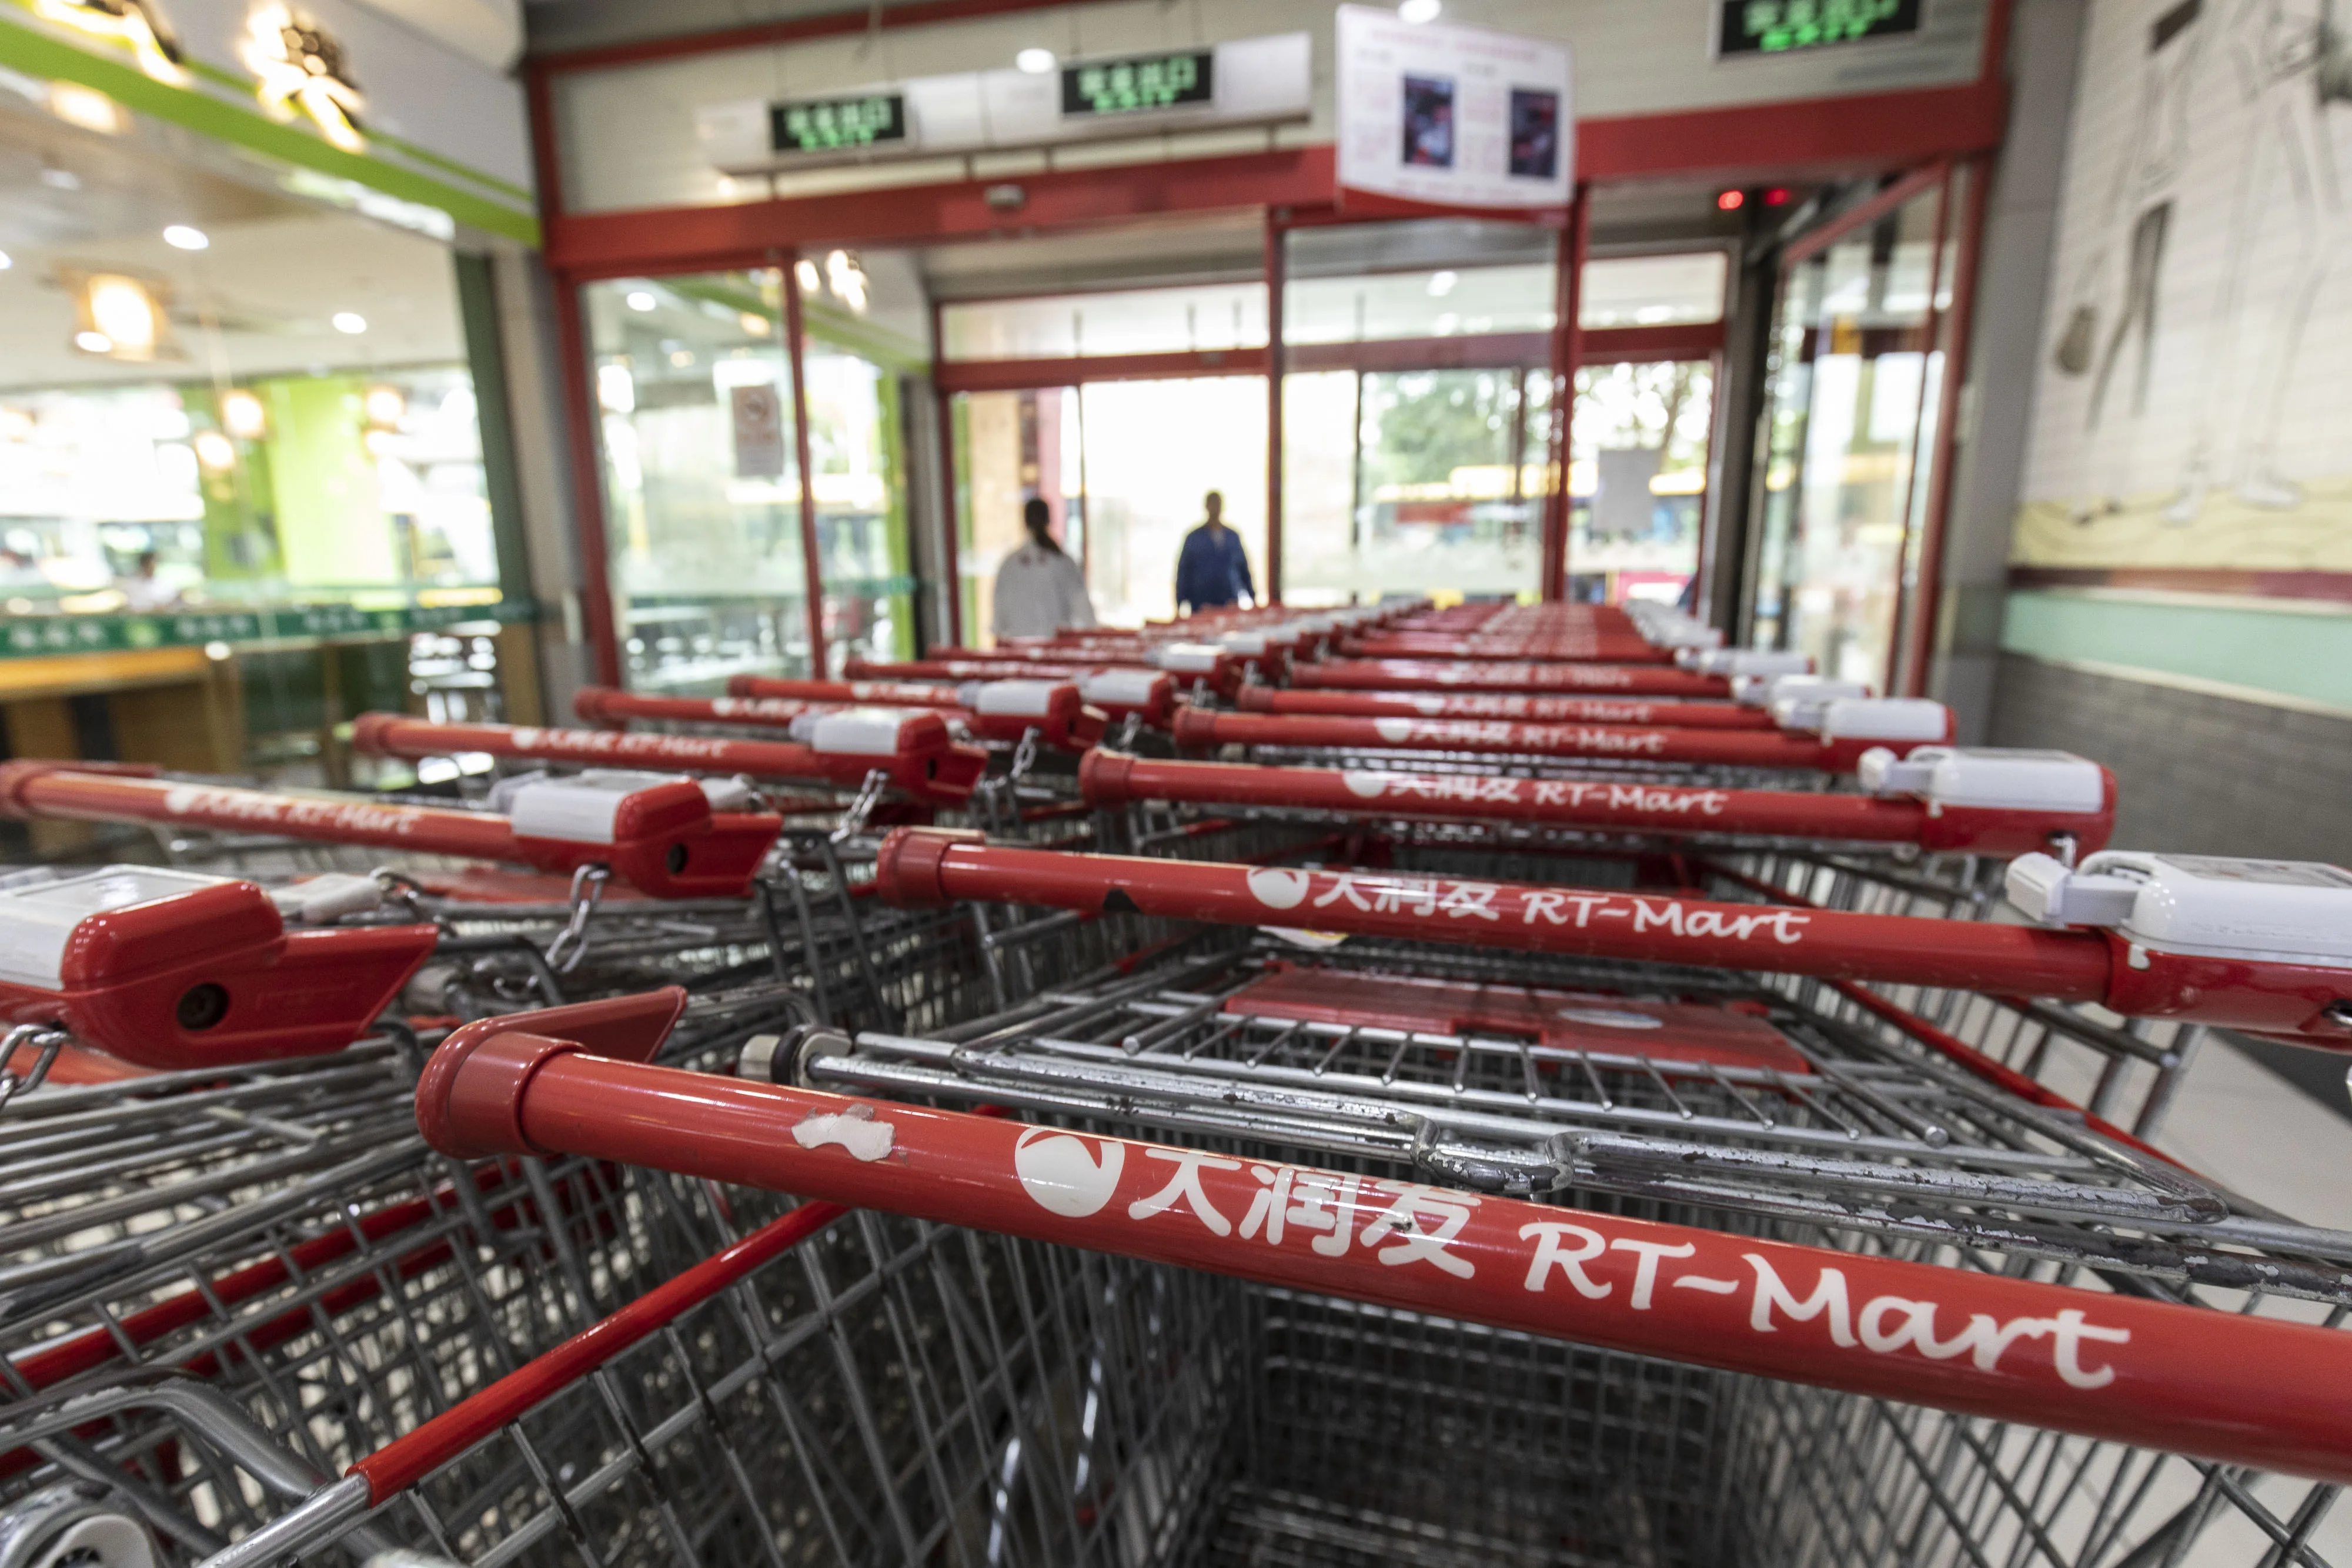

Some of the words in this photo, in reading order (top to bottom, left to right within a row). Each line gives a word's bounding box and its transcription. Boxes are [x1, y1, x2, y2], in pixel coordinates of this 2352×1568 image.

[1534, 780, 1729, 815] RT-Mart
[1519, 891, 1811, 944] RT-Mart
[1128, 1148, 1482, 1279] 大润发
[1518, 1221, 2131, 1389] RT-Mart
